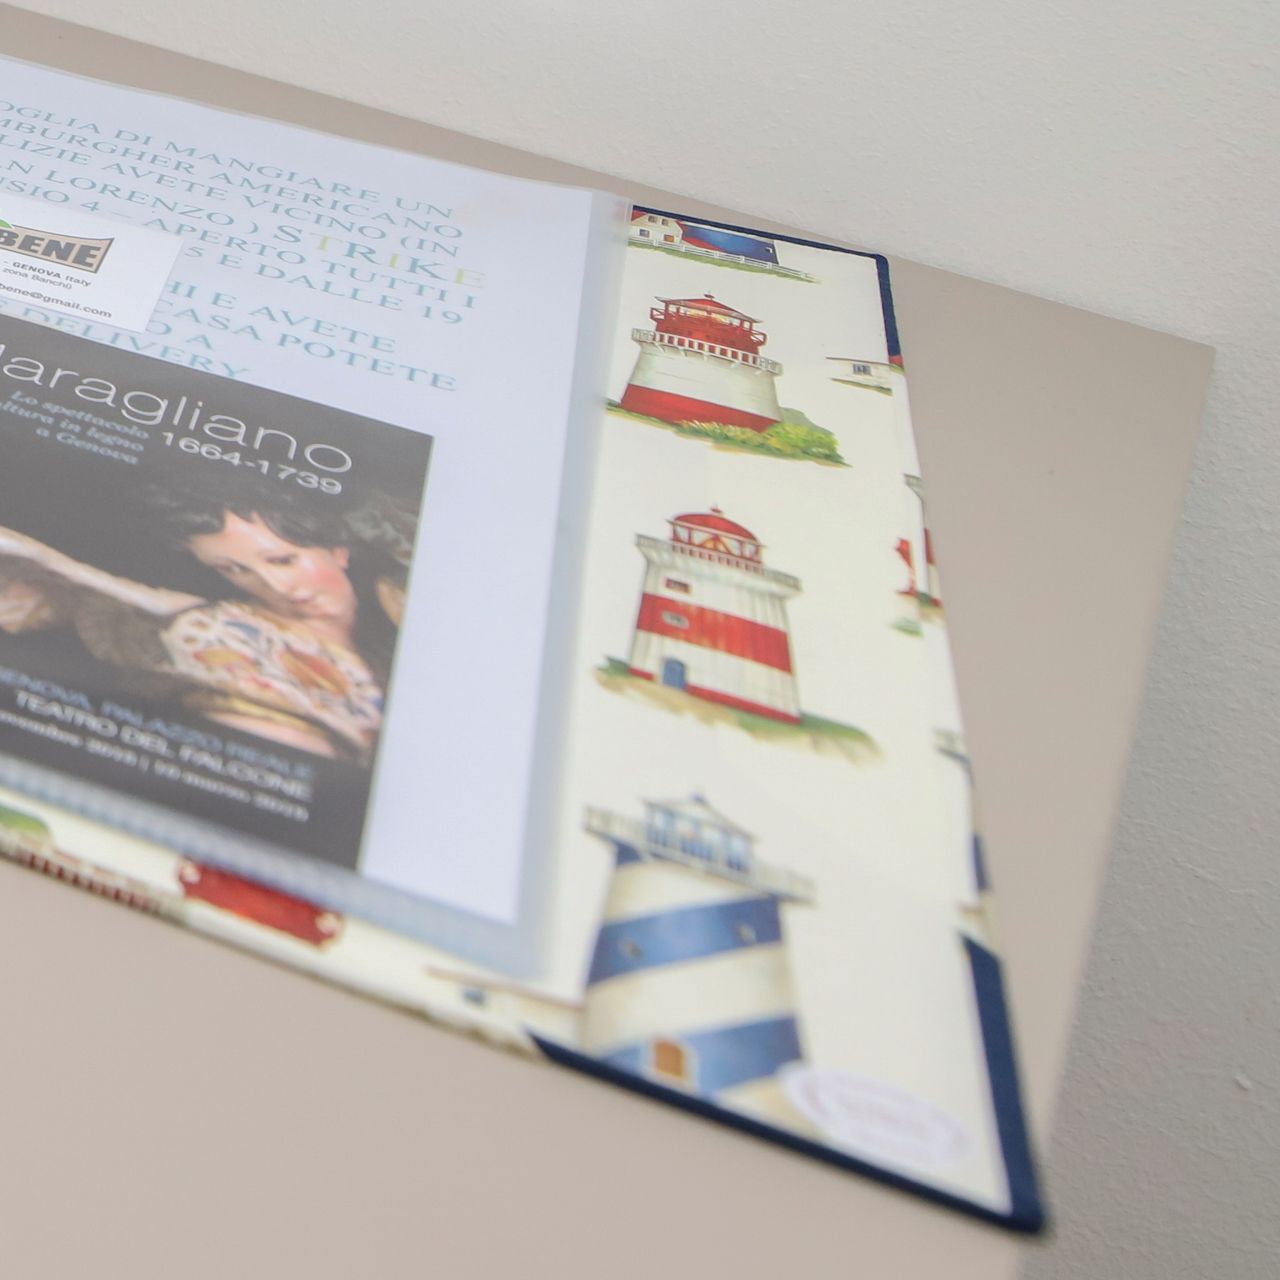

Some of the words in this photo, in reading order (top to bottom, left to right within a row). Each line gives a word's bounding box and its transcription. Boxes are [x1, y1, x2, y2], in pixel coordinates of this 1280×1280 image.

[101, 162, 229, 202] AVETE
[243, 194, 387, 241] VICINO
[114, 129, 152, 146] DI
[165, 141, 381, 202] MANGIARE
[395, 197, 454, 219] UN
[209, 172, 464, 239] AMERICANO
[43, 169, 235, 228] LORENZO
[273, 225, 488, 290] STRIKE
[80, 200, 107, 213] 4
[141, 218, 306, 266] APERTO
[320, 260, 449, 302] TUTTI
[3, 266, 29, 279] zona
[12, 261, 62, 280] GENOVA
[65, 275, 91, 287] Italy
[219, 254, 243, 269] E
[255, 263, 404, 312] DALLE
[421, 305, 465, 325] 19
[211, 292, 238, 310] E
[248, 306, 398, 353] AVETE
[278, 334, 458, 392] POTETE
[10, 389, 39, 406] Lo
[42, 400, 150, 440] spettacolo
[59, 419, 82, 434] in
[85, 426, 145, 452] legno
[55, 430, 139, 465] Genova
[161, 431, 343, 496] 1664-1739
